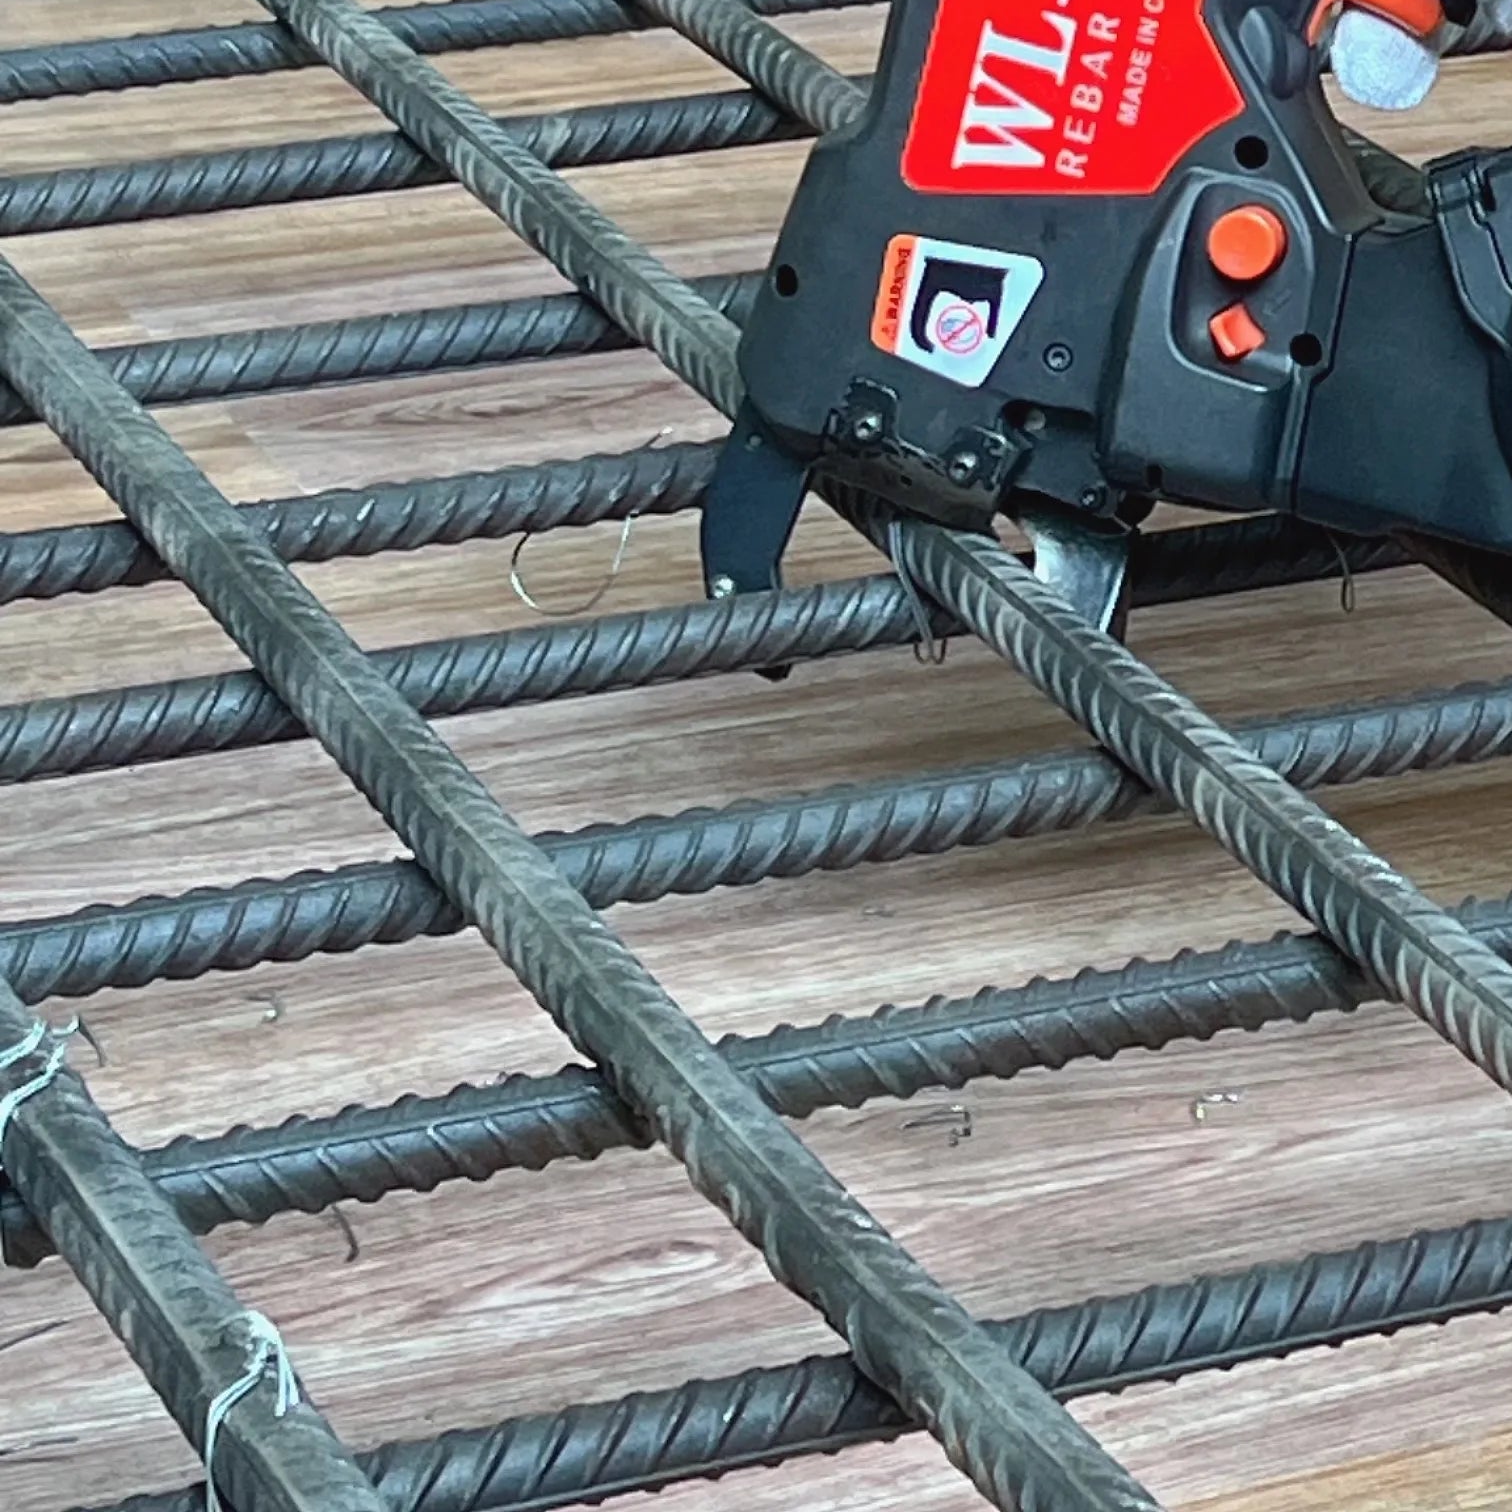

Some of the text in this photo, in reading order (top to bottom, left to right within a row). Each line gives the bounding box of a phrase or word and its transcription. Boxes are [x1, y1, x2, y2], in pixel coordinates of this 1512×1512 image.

[1055, 11, 1121, 179] REBAR
[1116, 48, 1152, 128] MADE
[1135, 16, 1160, 47] IN
